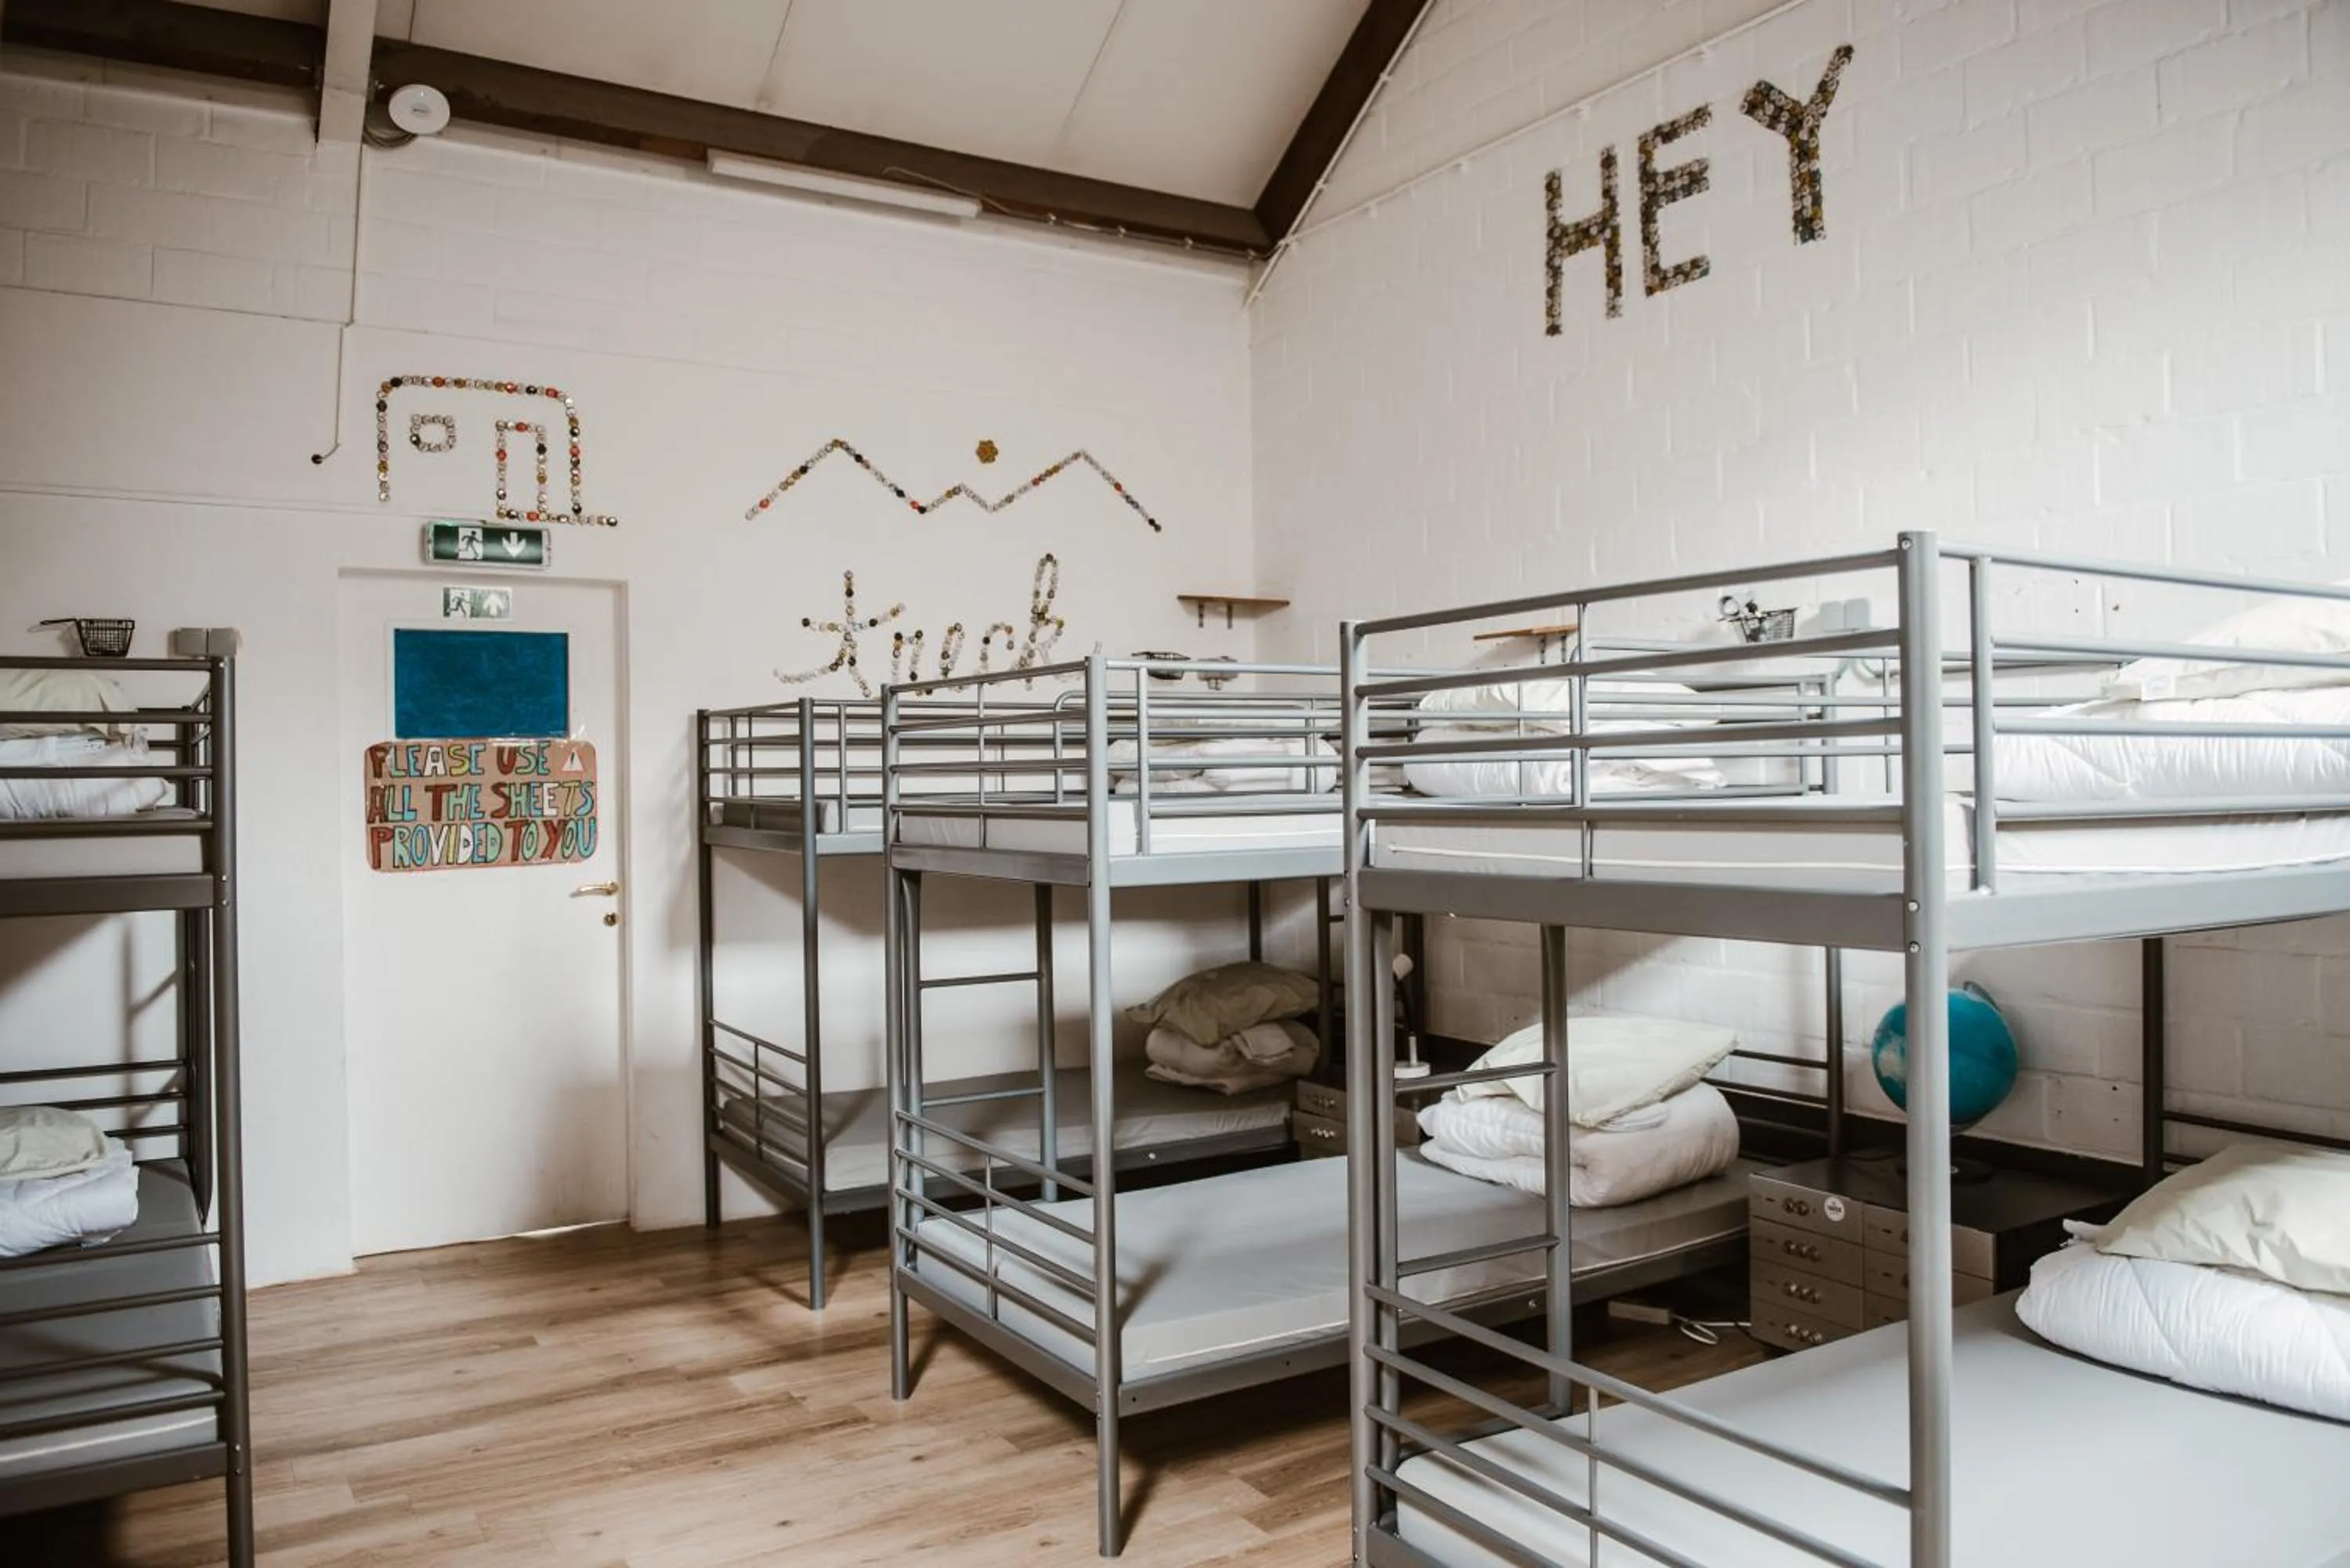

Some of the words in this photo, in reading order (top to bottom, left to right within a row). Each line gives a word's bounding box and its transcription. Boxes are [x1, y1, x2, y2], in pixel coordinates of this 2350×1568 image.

[1545, 44, 1854, 336] HEY
[369, 743, 486, 779] PLEASE
[497, 740, 551, 776] USE
[368, 782, 418, 823] ALL
[425, 783, 485, 821] THE
[490, 781, 595, 819] SHEETS
[371, 822, 504, 869] PROVIDED
[504, 820, 540, 862] TO
[540, 818, 597, 860] YOU
